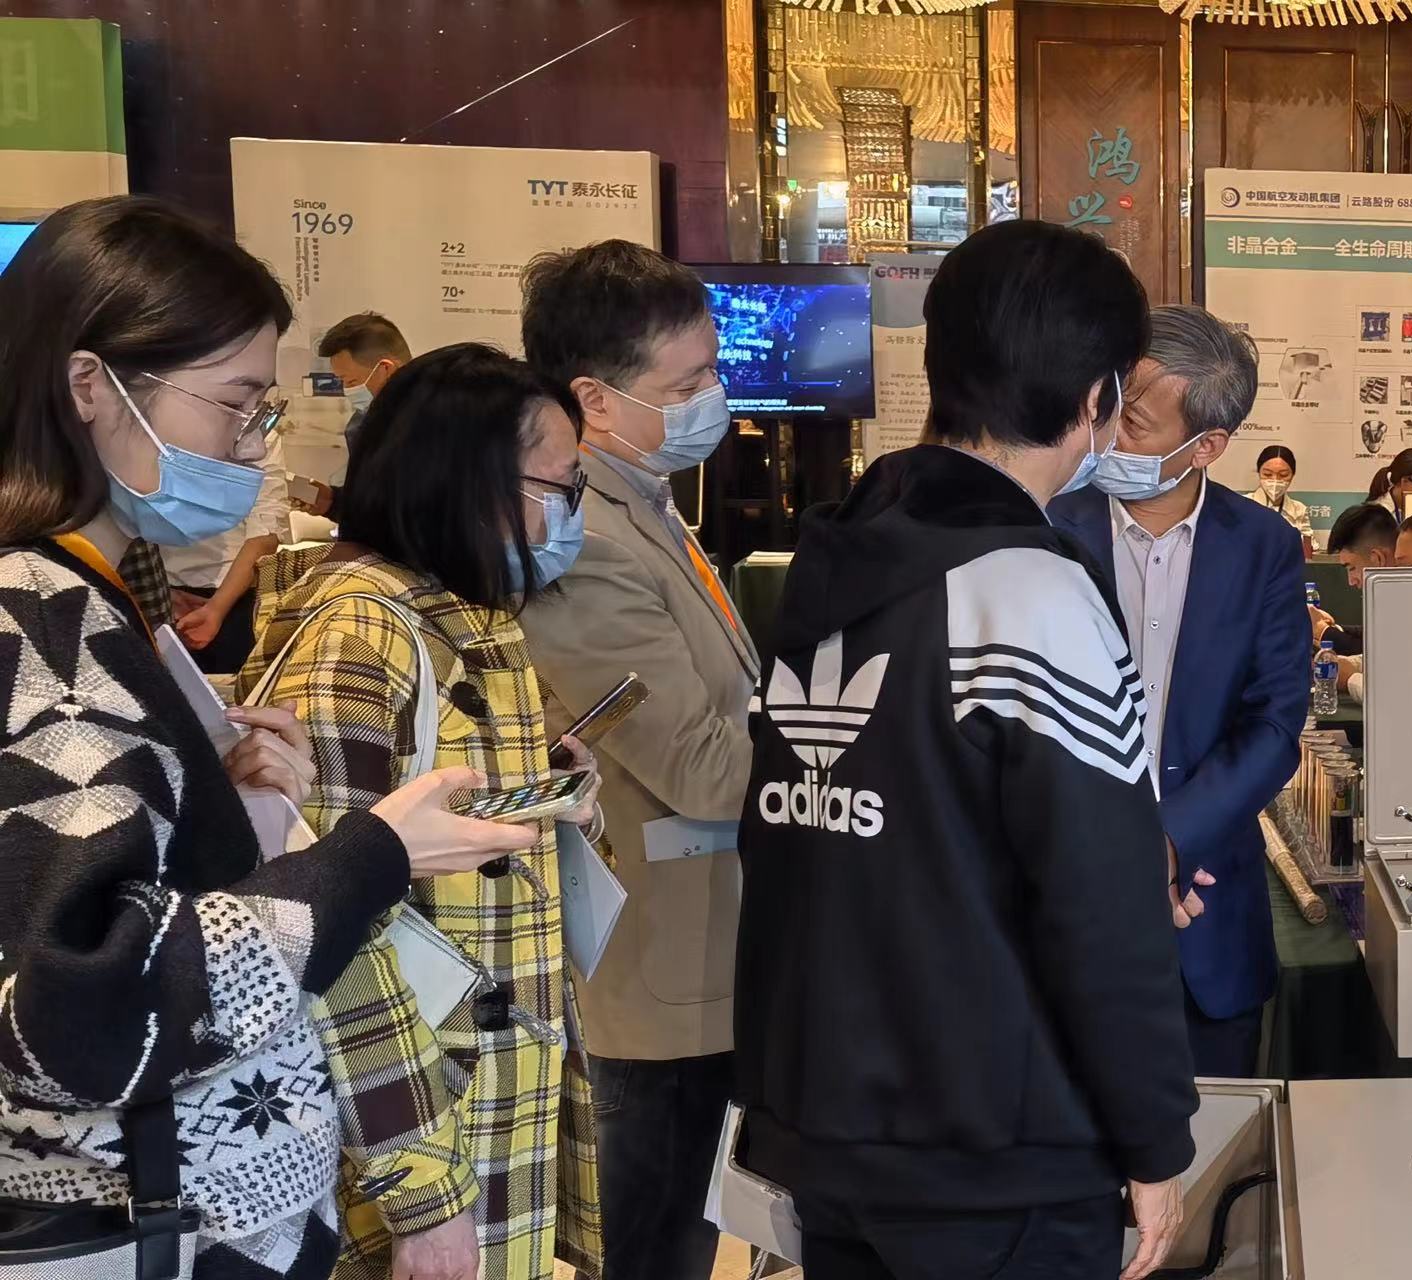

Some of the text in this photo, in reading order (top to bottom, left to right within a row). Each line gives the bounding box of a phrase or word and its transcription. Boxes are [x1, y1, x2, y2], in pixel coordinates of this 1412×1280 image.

[528, 180, 639, 199] TYT 泰永长征
[293, 199, 327, 210] Since
[1245, 190, 1340, 203] 中国航空发动机集团
[1352, 196, 1394, 208] 云路股份
[291, 212, 353, 235] 1969
[441, 242, 465, 253] 2+2
[441, 286, 465, 297] 70+
